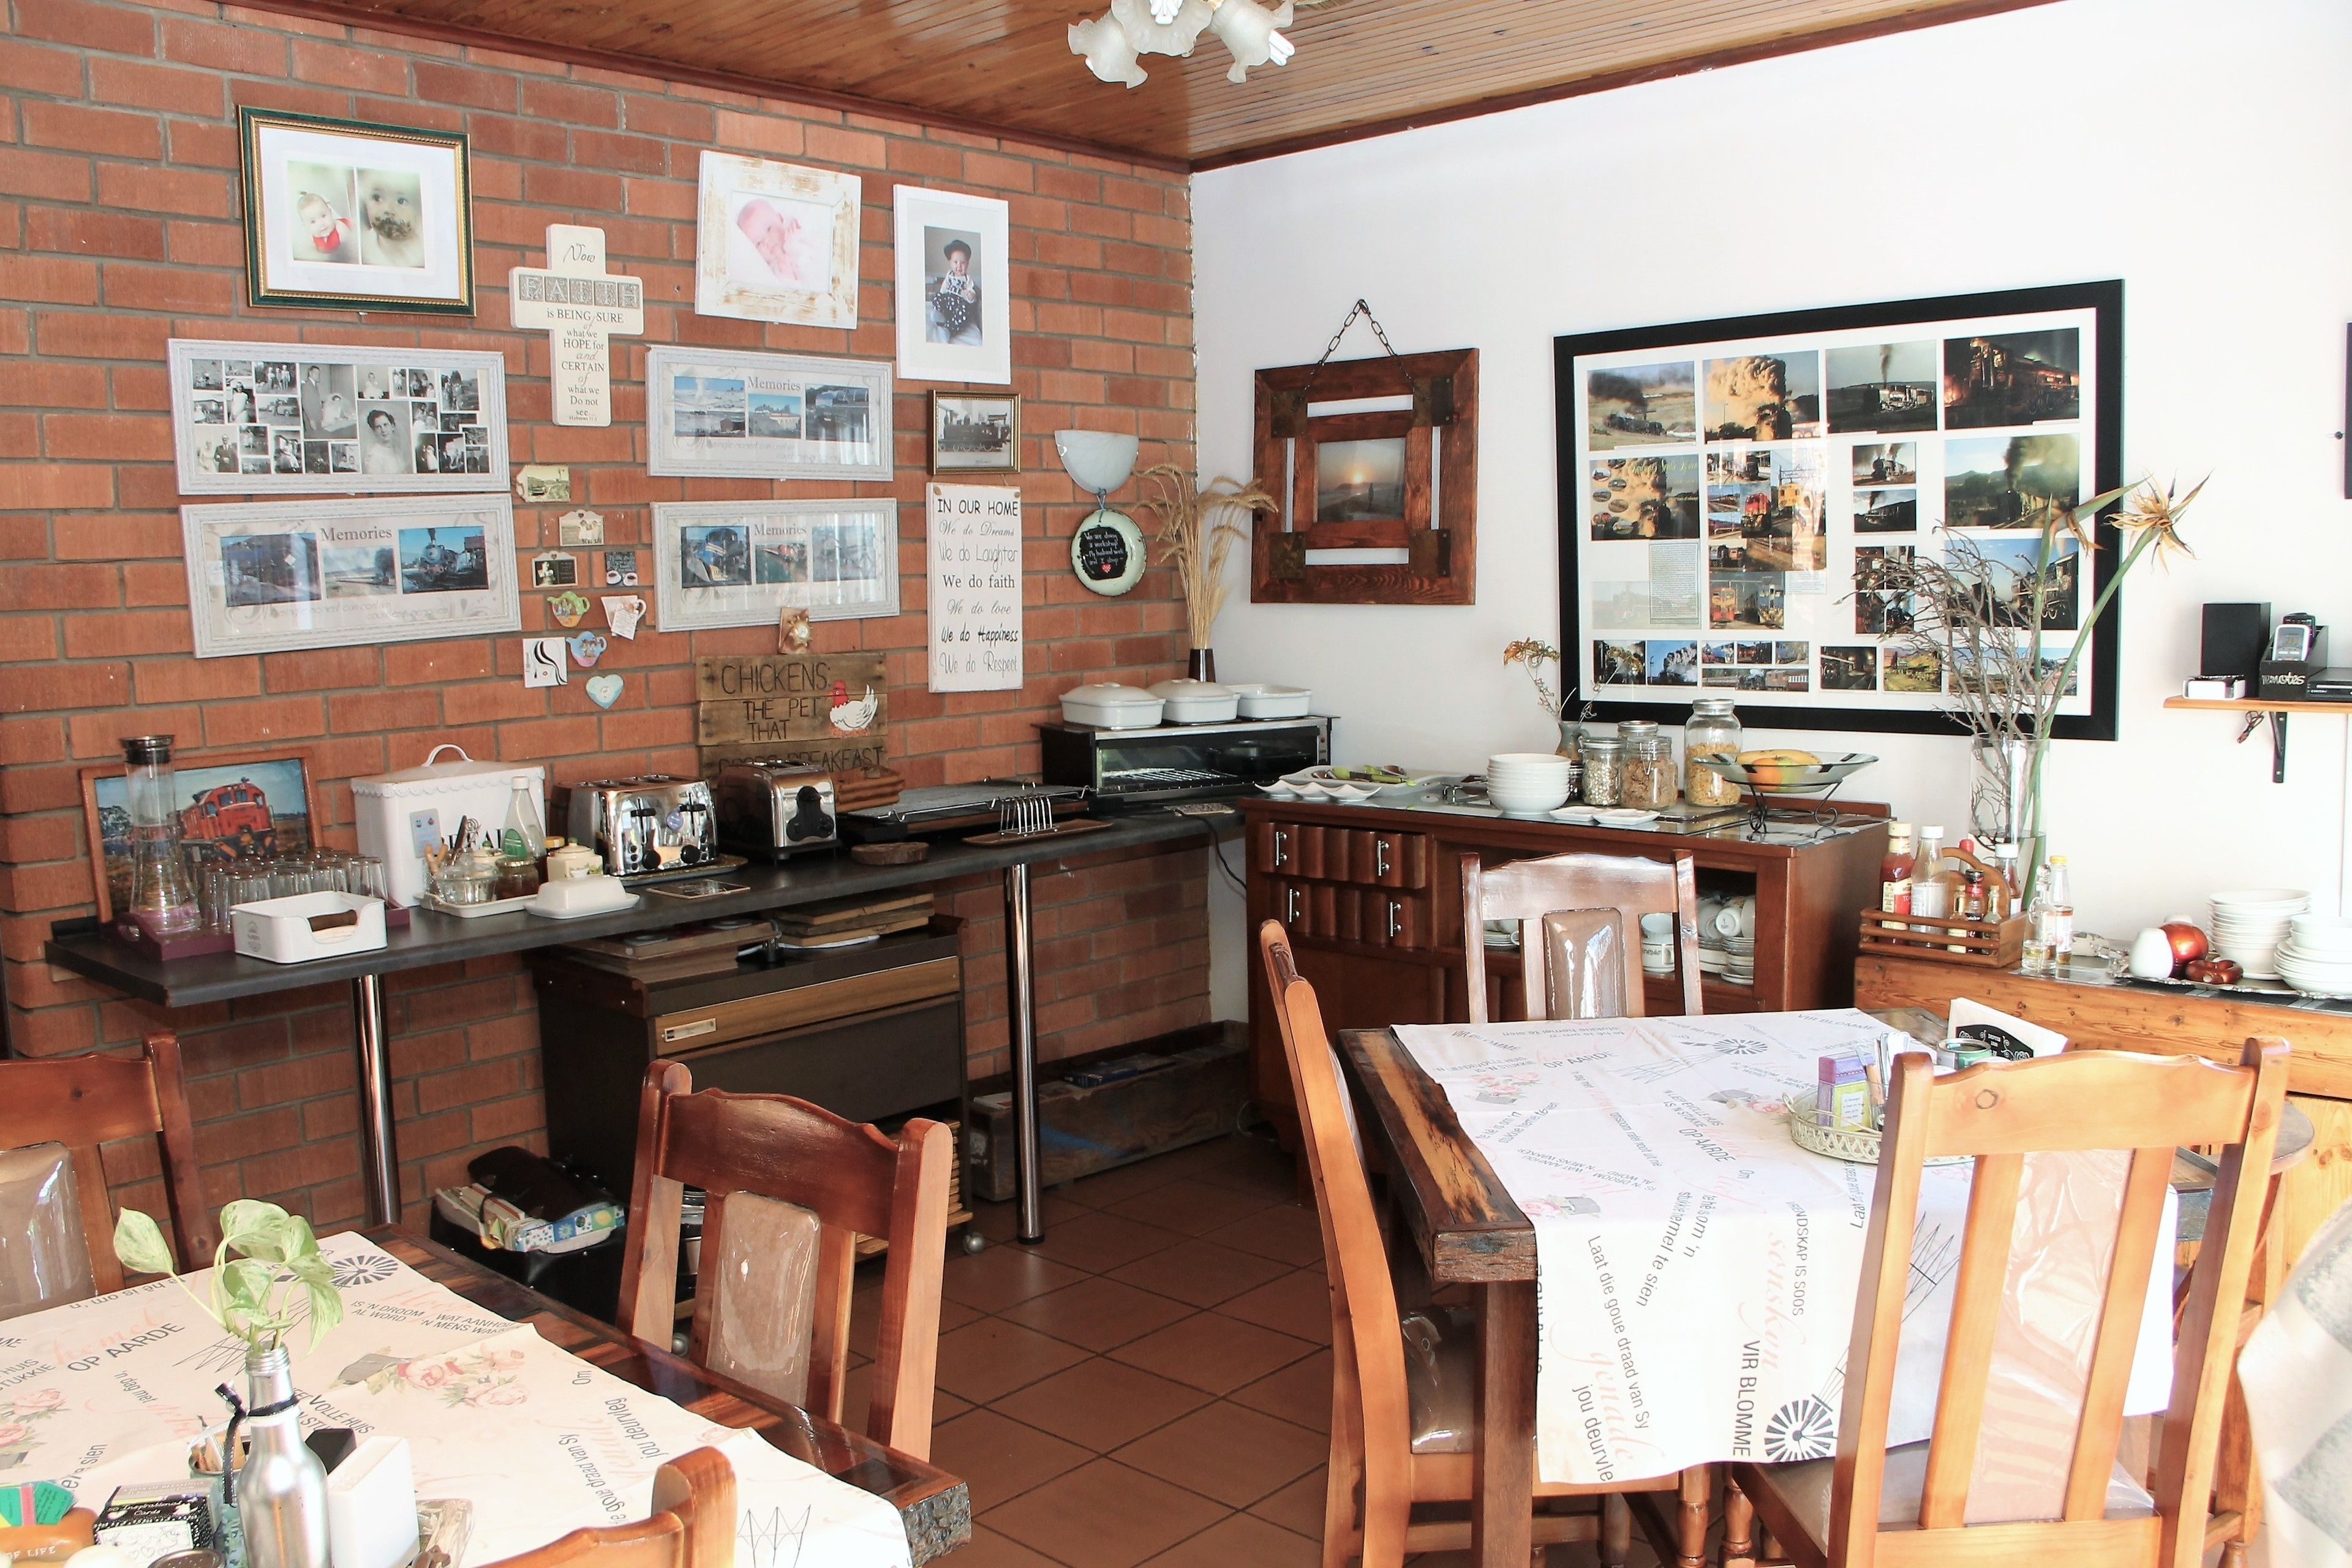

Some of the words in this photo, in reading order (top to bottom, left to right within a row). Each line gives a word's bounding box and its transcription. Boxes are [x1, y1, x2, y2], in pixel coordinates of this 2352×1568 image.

[563, 244, 595, 263] Now
[523, 277, 638, 307] FAITH
[547, 308, 554, 318] is
[557, 309, 590, 321] BEING
[596, 312, 624, 323] SURE
[567, 328, 586, 337] what
[564, 338, 590, 350] HOPE
[593, 341, 605, 350] for
[576, 350, 598, 361] and
[562, 361, 605, 372] CERTAIN
[568, 384, 587, 393] what
[578, 372, 590, 386] of
[748, 376, 801, 391] Memories
[570, 396, 583, 404] Do
[938, 499, 952, 513] IN
[959, 499, 981, 514] OUR
[988, 501, 1019, 516] HOME
[320, 526, 393, 541] Memories
[755, 524, 807, 537] Memories
[939, 518, 960, 535] We
[963, 524, 973, 535] do
[980, 521, 1014, 537] Dreams
[938, 541, 952, 562] We
[959, 543, 970, 562] do
[976, 543, 1017, 573] Laughter
[943, 575, 961, 588] We
[968, 574, 982, 588] do
[990, 574, 1015, 588] faith
[948, 598, 964, 614] We
[971, 601, 983, 614] do
[990, 600, 1011, 614] love
[941, 625, 953, 643] We
[960, 622, 970, 642] do
[978, 622, 1018, 647] Happiness
[939, 652, 958, 674] We
[966, 653, 976, 673] do
[983, 650, 1017, 678] Respect
[722, 662, 831, 695] CHICKENS:
[743, 699, 774, 721] THE
[788, 697, 822, 718] PET
[748, 719, 790, 742] THAT
[1543, 1060, 1563, 1069] OP
[1567, 1050, 1619, 1065] AARDE
[1679, 1128, 1704, 1139] OP
[1694, 1138, 1736, 1163] AARDE
[1593, 1172, 1632, 1185] DROOM
[1737, 1168, 1755, 1180] Om
[1660, 1212, 1686, 1253] hemel
[1588, 1235, 1608, 1271] Laat
[1683, 1245, 1701, 1258] 'n
[1653, 1254, 1669, 1270] te
[1795, 1265, 1807, 1277] IS
[1599, 1272, 1616, 1295] die
[1636, 1273, 1659, 1307] sien
[91, 1294, 119, 1305] om
[1792, 1280, 1806, 1316] SOOS
[369, 1311, 407, 1322] WORD
[378, 1305, 426, 1317] DROOM
[434, 1313, 463, 1321] WAT
[1604, 1298, 1626, 1335] goue
[434, 1321, 472, 1332] MENS
[67, 1355, 100, 1372] OP
[105, 1323, 186, 1359] AARDE
[1741, 1340, 1761, 1370] VIR
[0, 1359, 39, 1375] HUIS
[1617, 1337, 1639, 1379] draad
[572, 1370, 592, 1385] Om
[120, 1377, 141, 1392] dag
[133, 1389, 158, 1404] met
[1572, 1384, 1594, 1414] jou
[1628, 1383, 1644, 1408] van
[341, 1415, 375, 1434] HUIS
[605, 1396, 650, 1440] deurvleg
[1634, 1411, 1650, 1431] Sy
[1732, 1376, 1757, 1457] BLOMME
[558, 1434, 580, 1446] Sy
[625, 1439, 669, 1460] jou
[80, 1443, 108, 1465] sien
[567, 1444, 589, 1463] van
[578, 1462, 606, 1488] draad
[28, 1545, 57, 1557] LIFE
